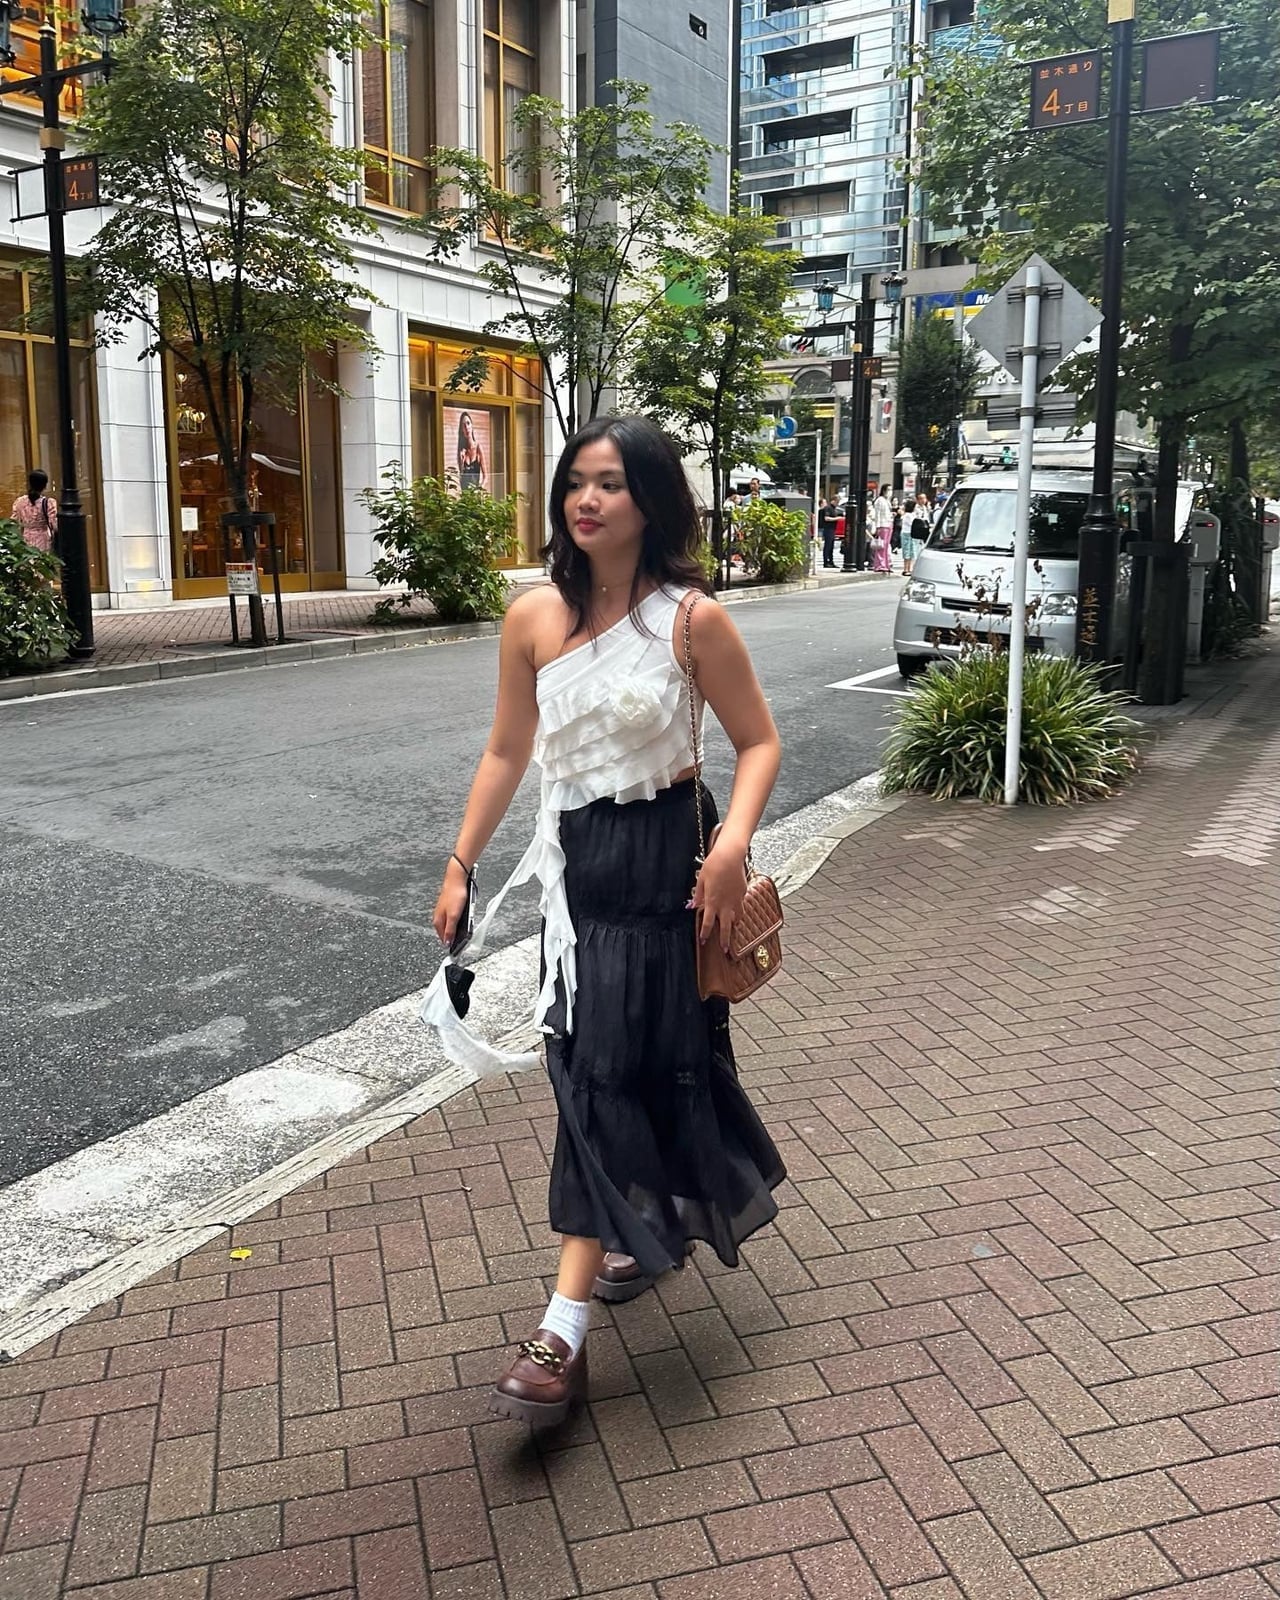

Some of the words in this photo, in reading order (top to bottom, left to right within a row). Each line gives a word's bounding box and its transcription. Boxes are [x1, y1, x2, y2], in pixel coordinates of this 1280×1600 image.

[1039, 60, 1094, 79] 並木通り
[1041, 88, 1088, 116] 4丁目
